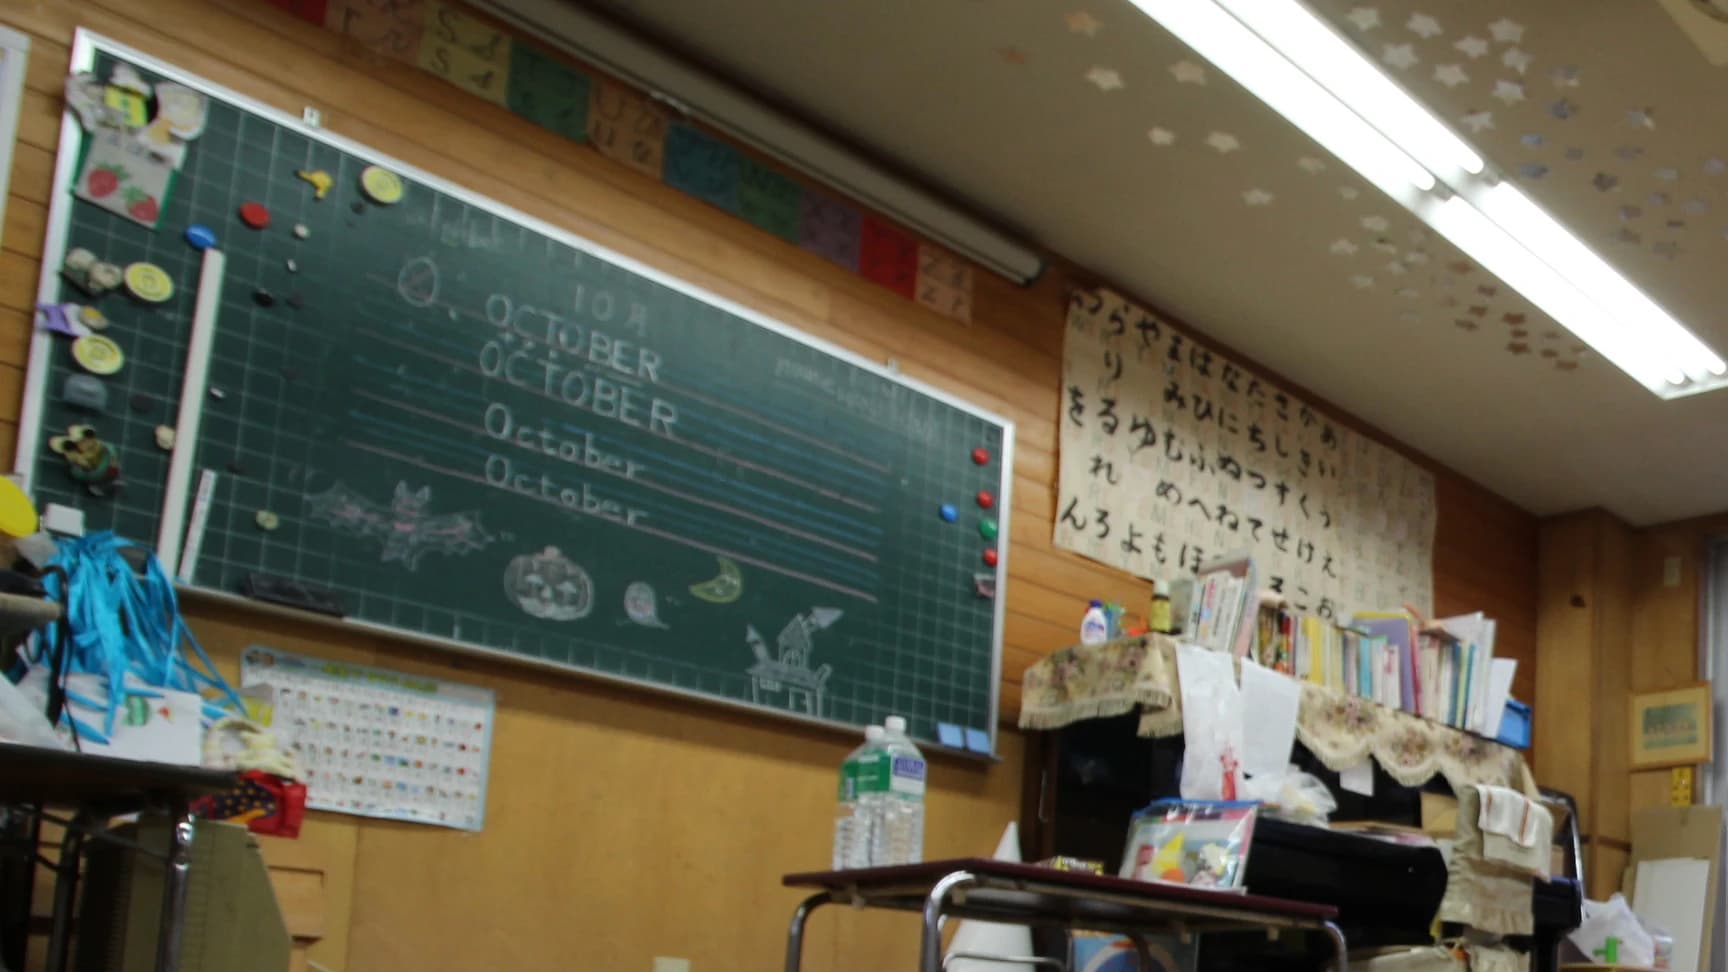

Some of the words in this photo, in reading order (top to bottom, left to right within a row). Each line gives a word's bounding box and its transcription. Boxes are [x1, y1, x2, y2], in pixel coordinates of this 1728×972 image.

[485, 293, 662, 383] OCTOBER
[479, 340, 678, 437] OCTOBER
[484, 401, 646, 480] October
[485, 453, 649, 528] October
